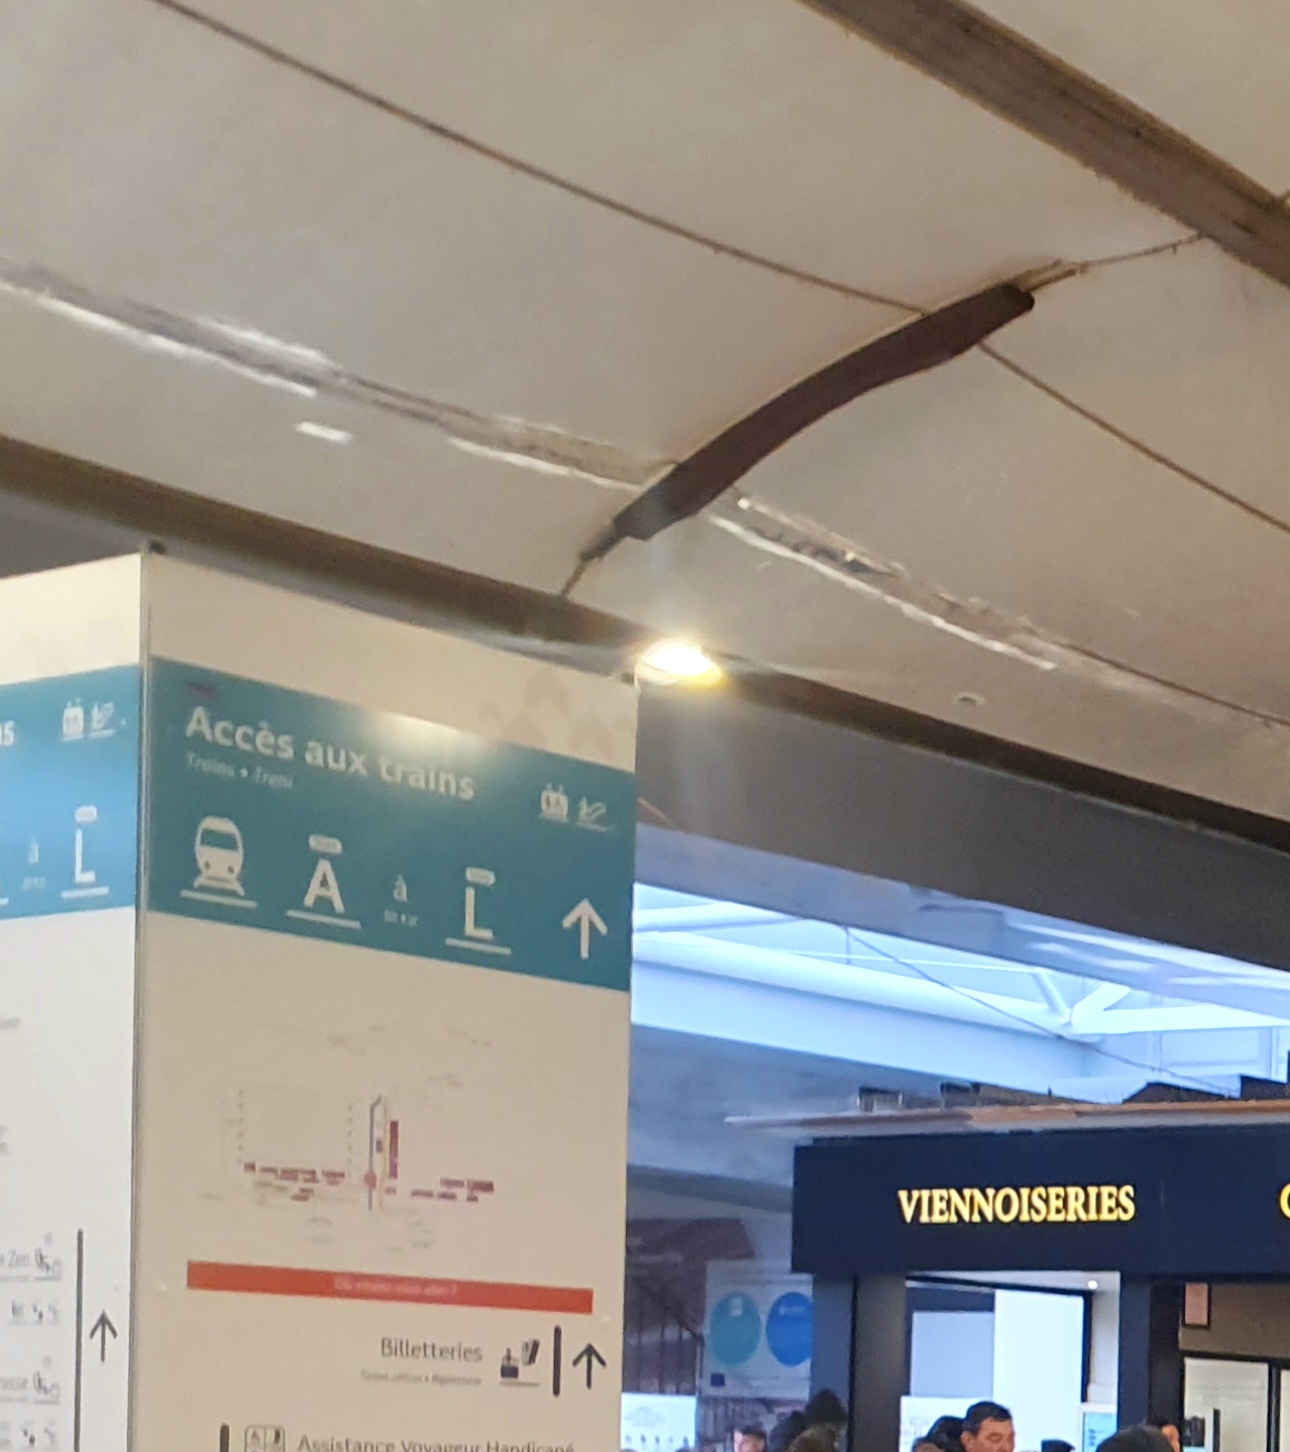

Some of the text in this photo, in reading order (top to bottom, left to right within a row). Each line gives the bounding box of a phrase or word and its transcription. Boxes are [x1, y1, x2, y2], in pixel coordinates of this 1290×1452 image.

[186, 705, 475, 801] Accès aux trains
[303, 857, 346, 915] A
[465, 885, 494, 940] L
[898, 1185, 1136, 1225] VIENNOISERIES
[381, 1337, 483, 1363] Billetteries
